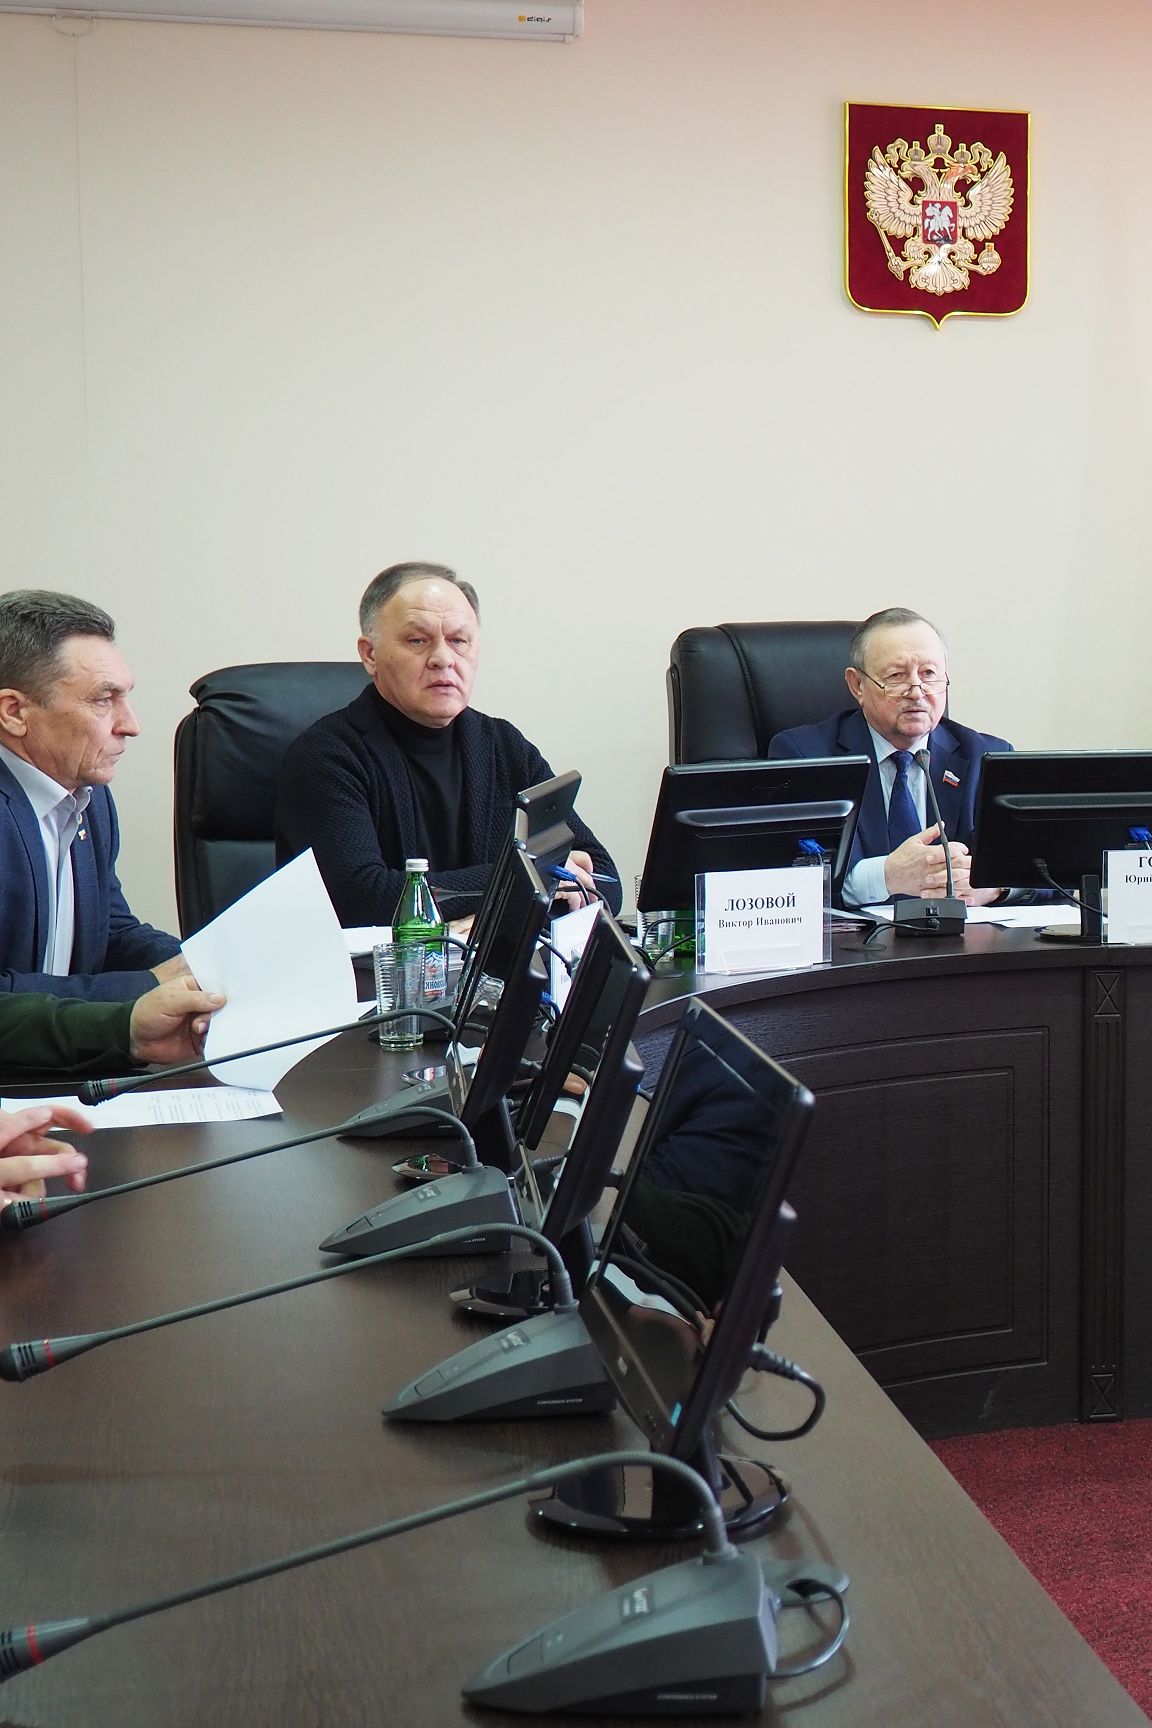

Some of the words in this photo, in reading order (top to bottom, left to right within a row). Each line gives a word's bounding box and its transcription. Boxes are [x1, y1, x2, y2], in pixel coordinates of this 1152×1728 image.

[724, 892, 797, 912] ЛОЗОВОЙ
[718, 919, 753, 929] Виктор
[756, 916, 802, 926] Иванович
